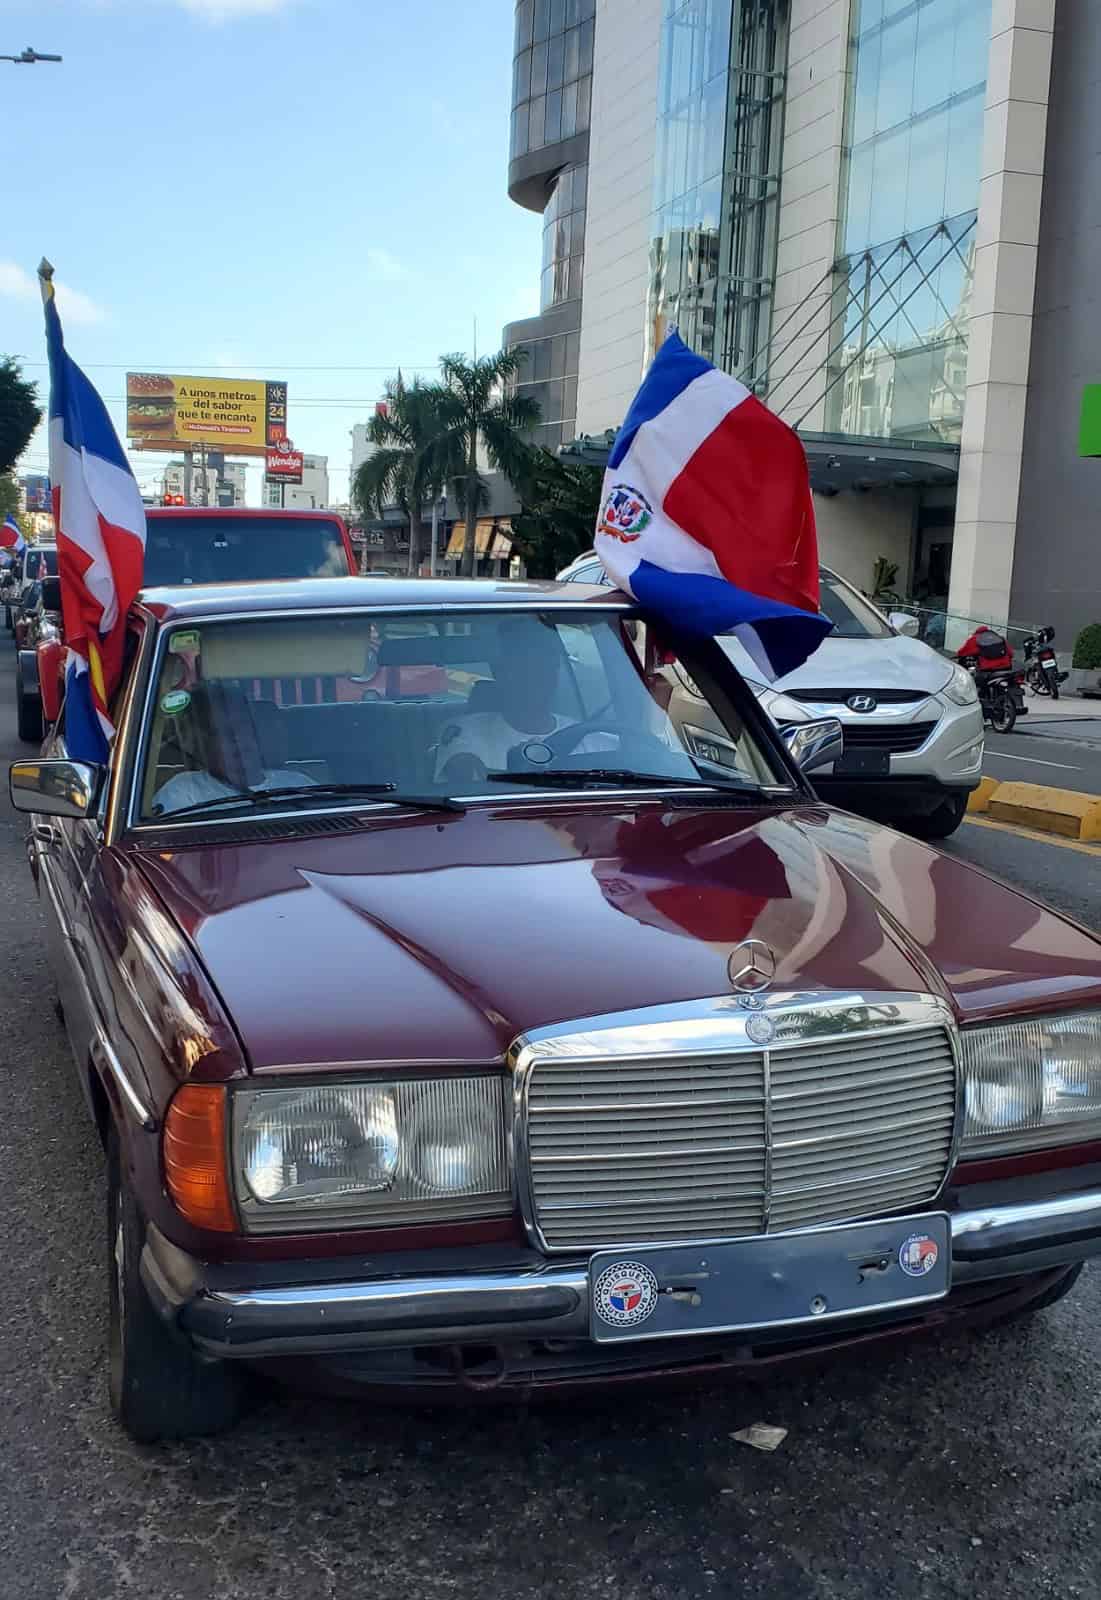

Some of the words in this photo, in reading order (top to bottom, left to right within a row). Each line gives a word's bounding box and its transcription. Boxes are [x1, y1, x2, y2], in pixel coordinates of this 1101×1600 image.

[180, 387, 188, 397] A
[190, 389, 216, 399] unos
[218, 391, 256, 402] metros
[193, 399, 210, 409] del
[212, 401, 242, 411] sabor
[269, 406, 284, 417] 24
[178, 411, 198, 420] que
[201, 411, 211, 419] te
[214, 412, 256, 423] encanta
[603, 1270, 649, 1295] QUISQUEYA
[603, 1303, 625, 1319] AUTO
[629, 1297, 649, 1317] CLUB
